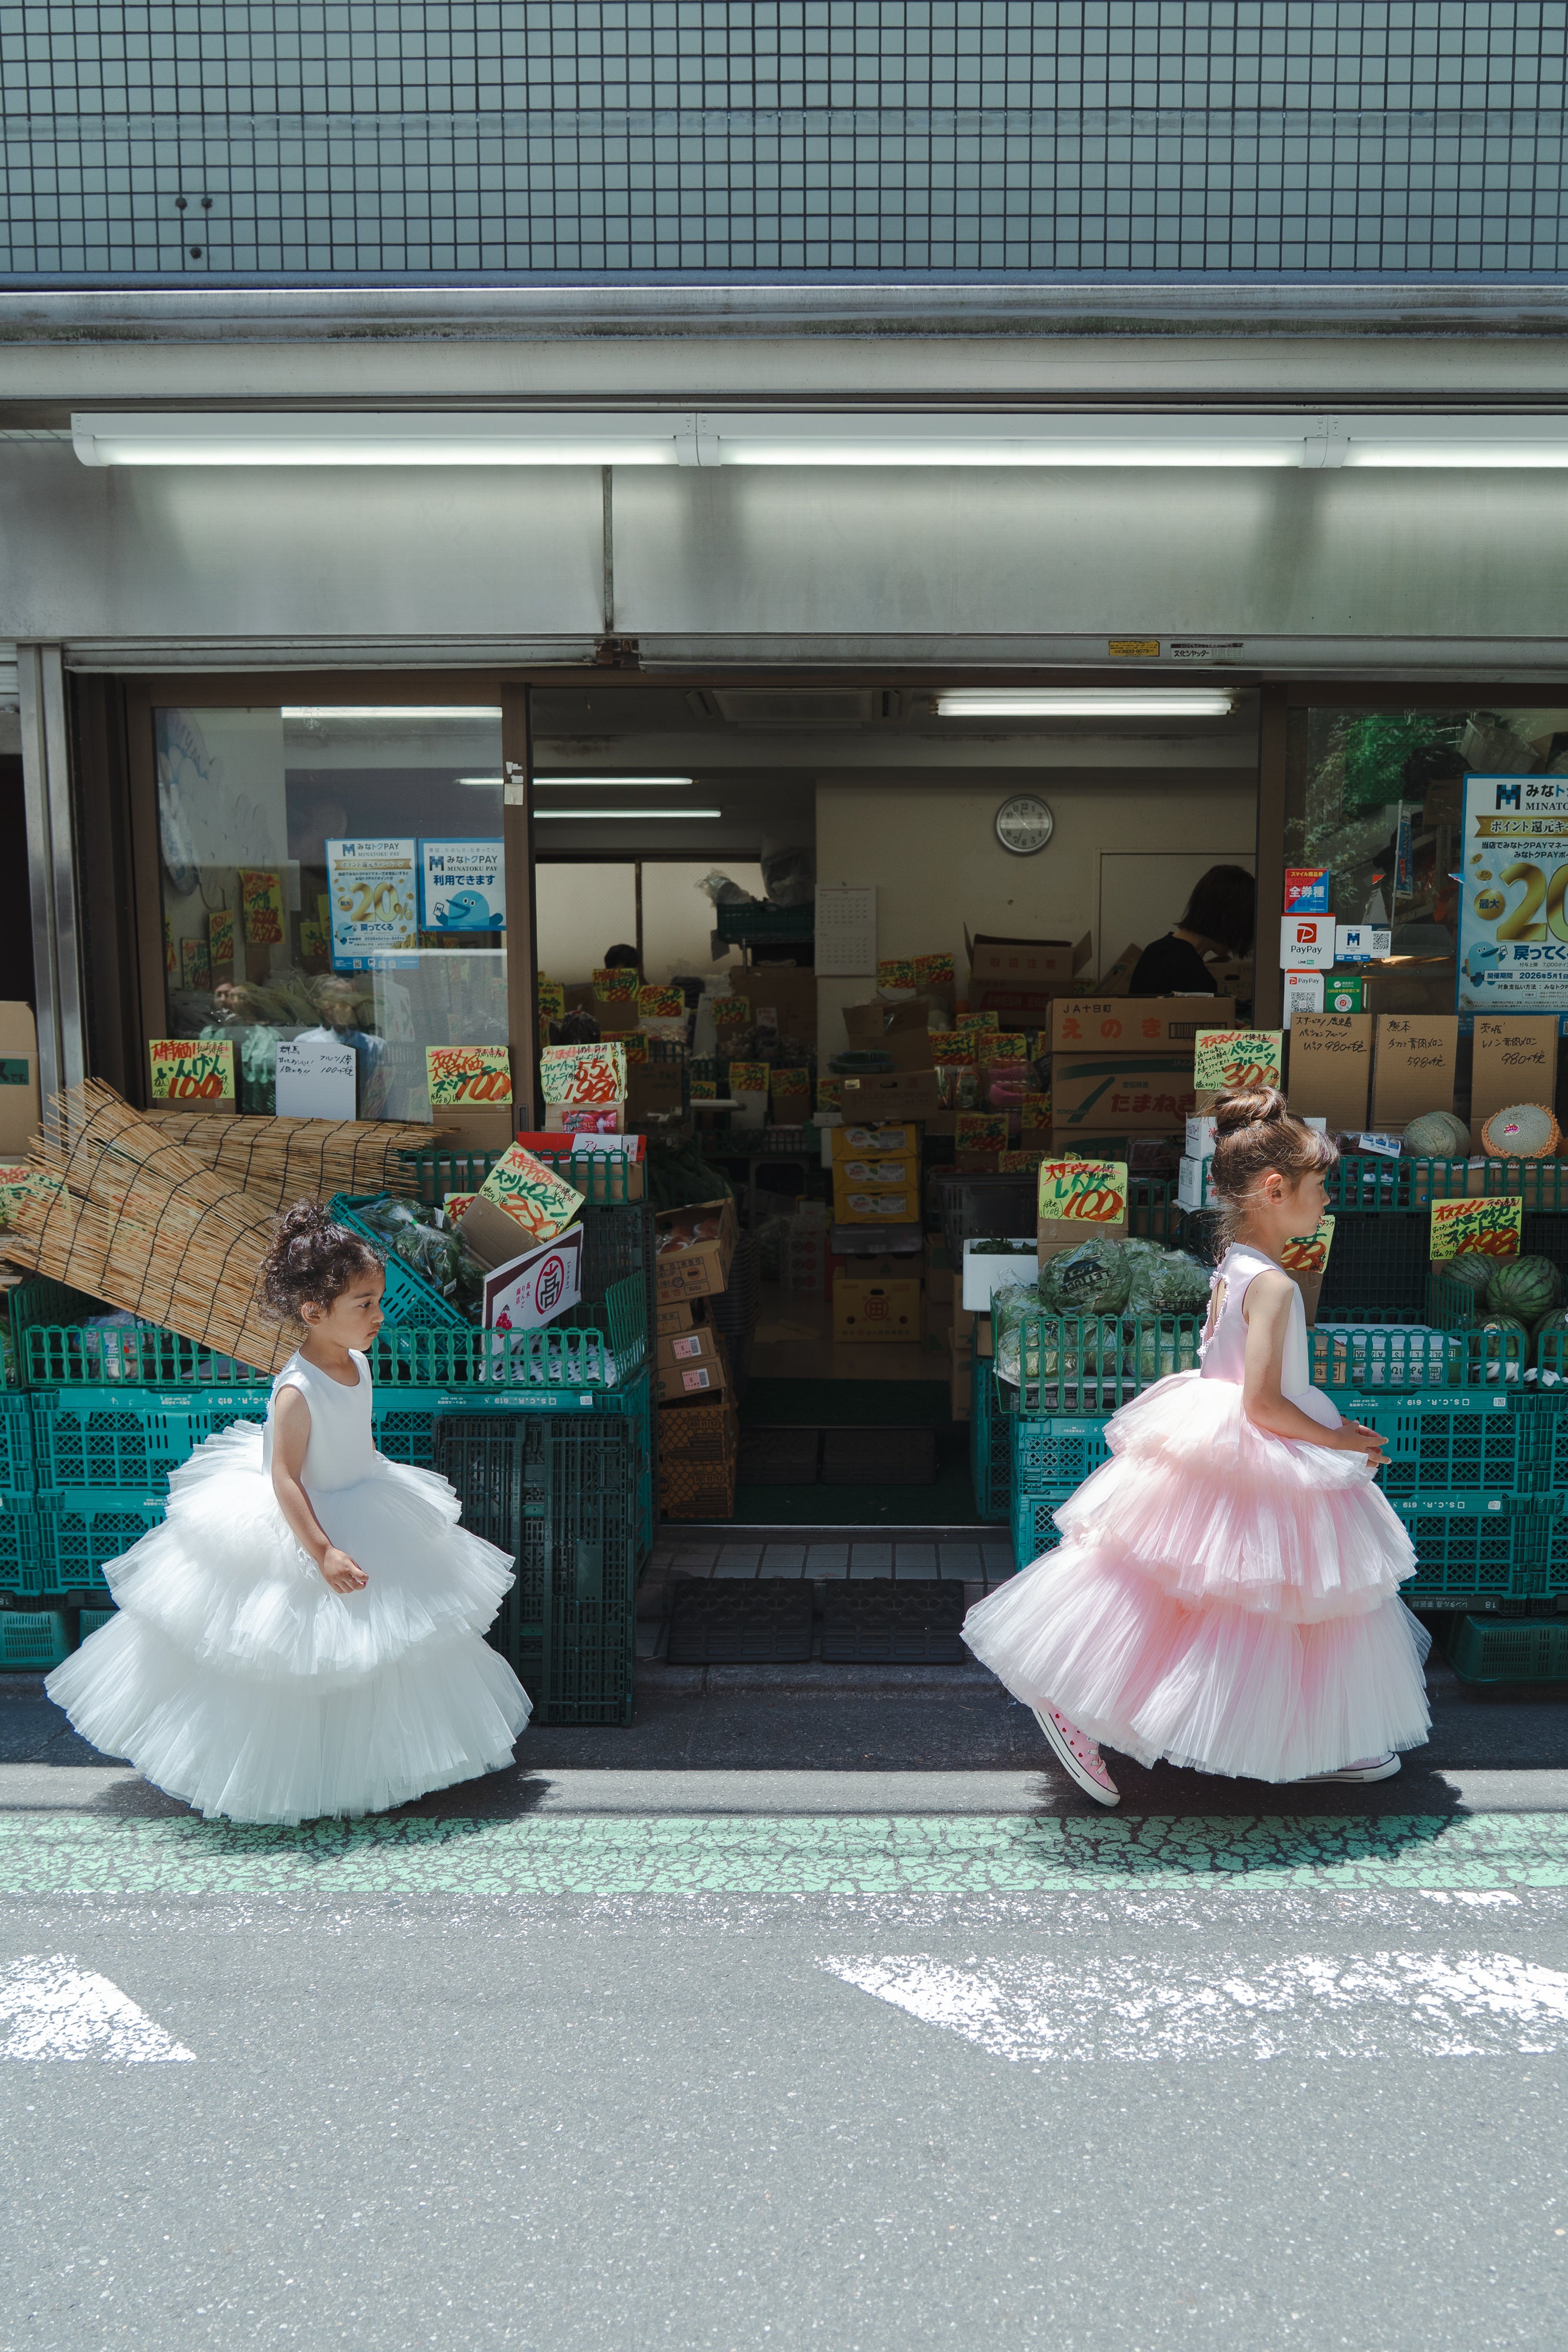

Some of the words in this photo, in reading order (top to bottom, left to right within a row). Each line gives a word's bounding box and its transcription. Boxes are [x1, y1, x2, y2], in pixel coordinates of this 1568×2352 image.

[1526, 784, 1568, 797] みなト
[434, 875, 495, 886] 利用できます
[1289, 886, 1325, 898] 全券種
[1479, 899, 1500, 909] 最大
[1291, 946, 1322, 954] PayPay
[1514, 946, 1568, 960] 戻ってく
[1064, 1004, 1112, 1014] JA十日町
[1062, 1017, 1161, 1040] えのき
[1387, 1020, 1412, 1032] 熊本
[279, 1045, 300, 1054] 群馬
[1233, 1053, 1276, 1070] フルーツ
[157, 1054, 226, 1083] いんげん
[168, 1072, 223, 1098] 100
[1063, 1190, 1124, 1221] 100
[1059, 1270, 1111, 1295] LETTUCE
[1156, 1299, 1204, 1309] LETTUCE
